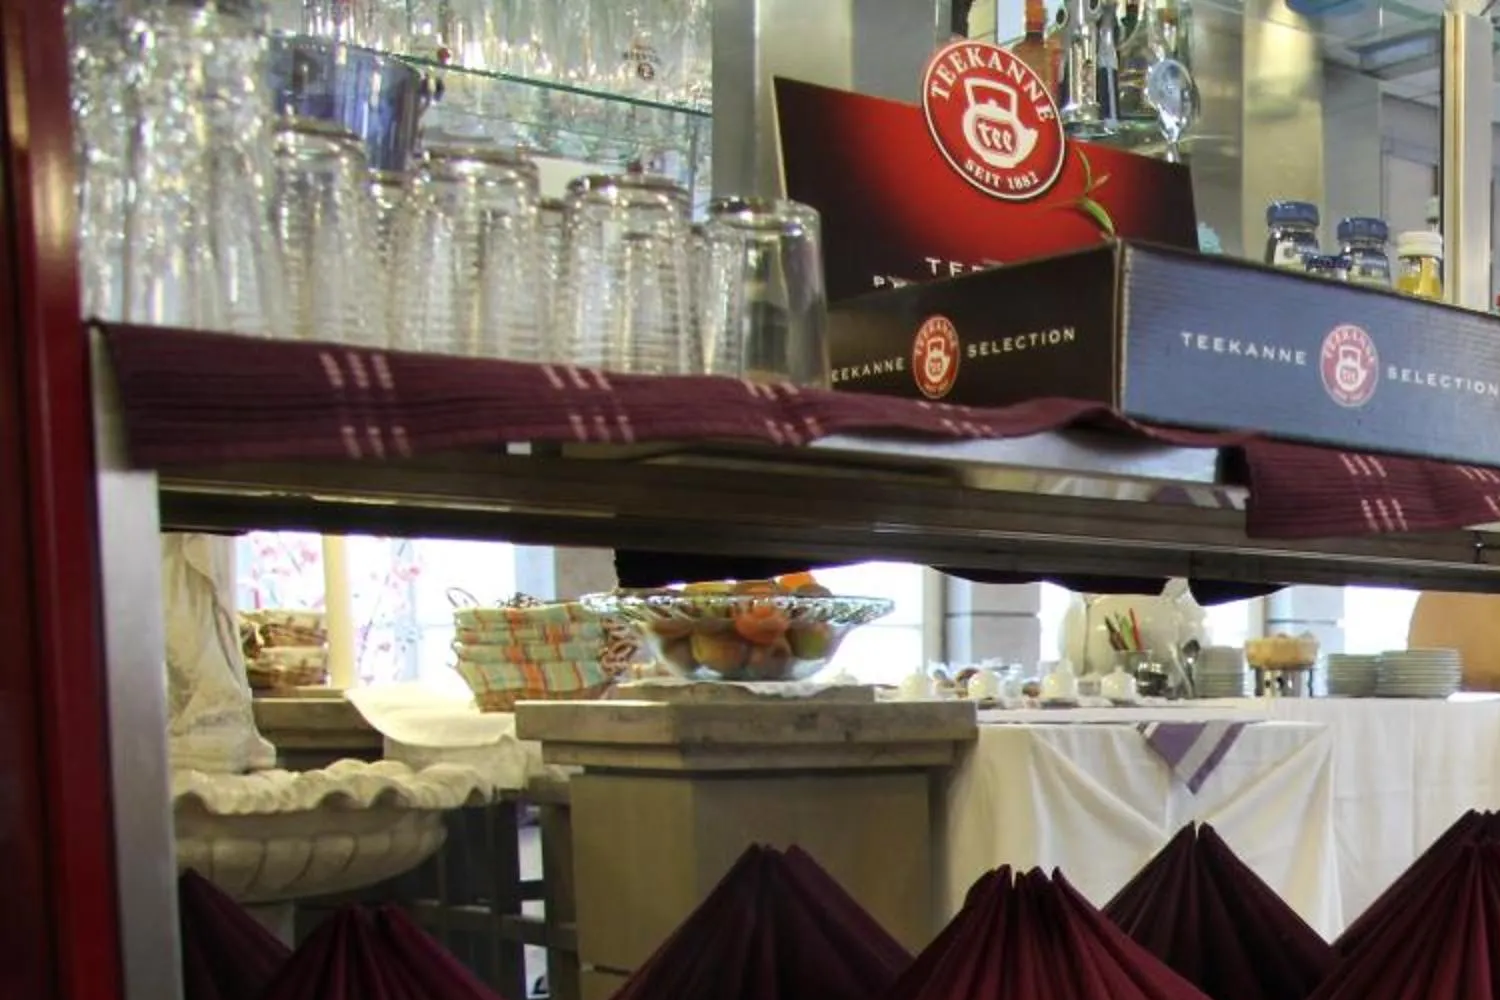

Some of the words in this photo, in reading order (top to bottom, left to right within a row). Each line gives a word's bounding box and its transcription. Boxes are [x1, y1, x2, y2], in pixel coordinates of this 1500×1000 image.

[930, 47, 1055, 122] TEEKANNE
[964, 158, 1001, 188] SEIT
[831, 357, 906, 383] EEKANNE
[966, 326, 1077, 358] SELECTION
[1180, 332, 1308, 366] TEEKANNE
[1387, 366, 1500, 397] SELECTION
